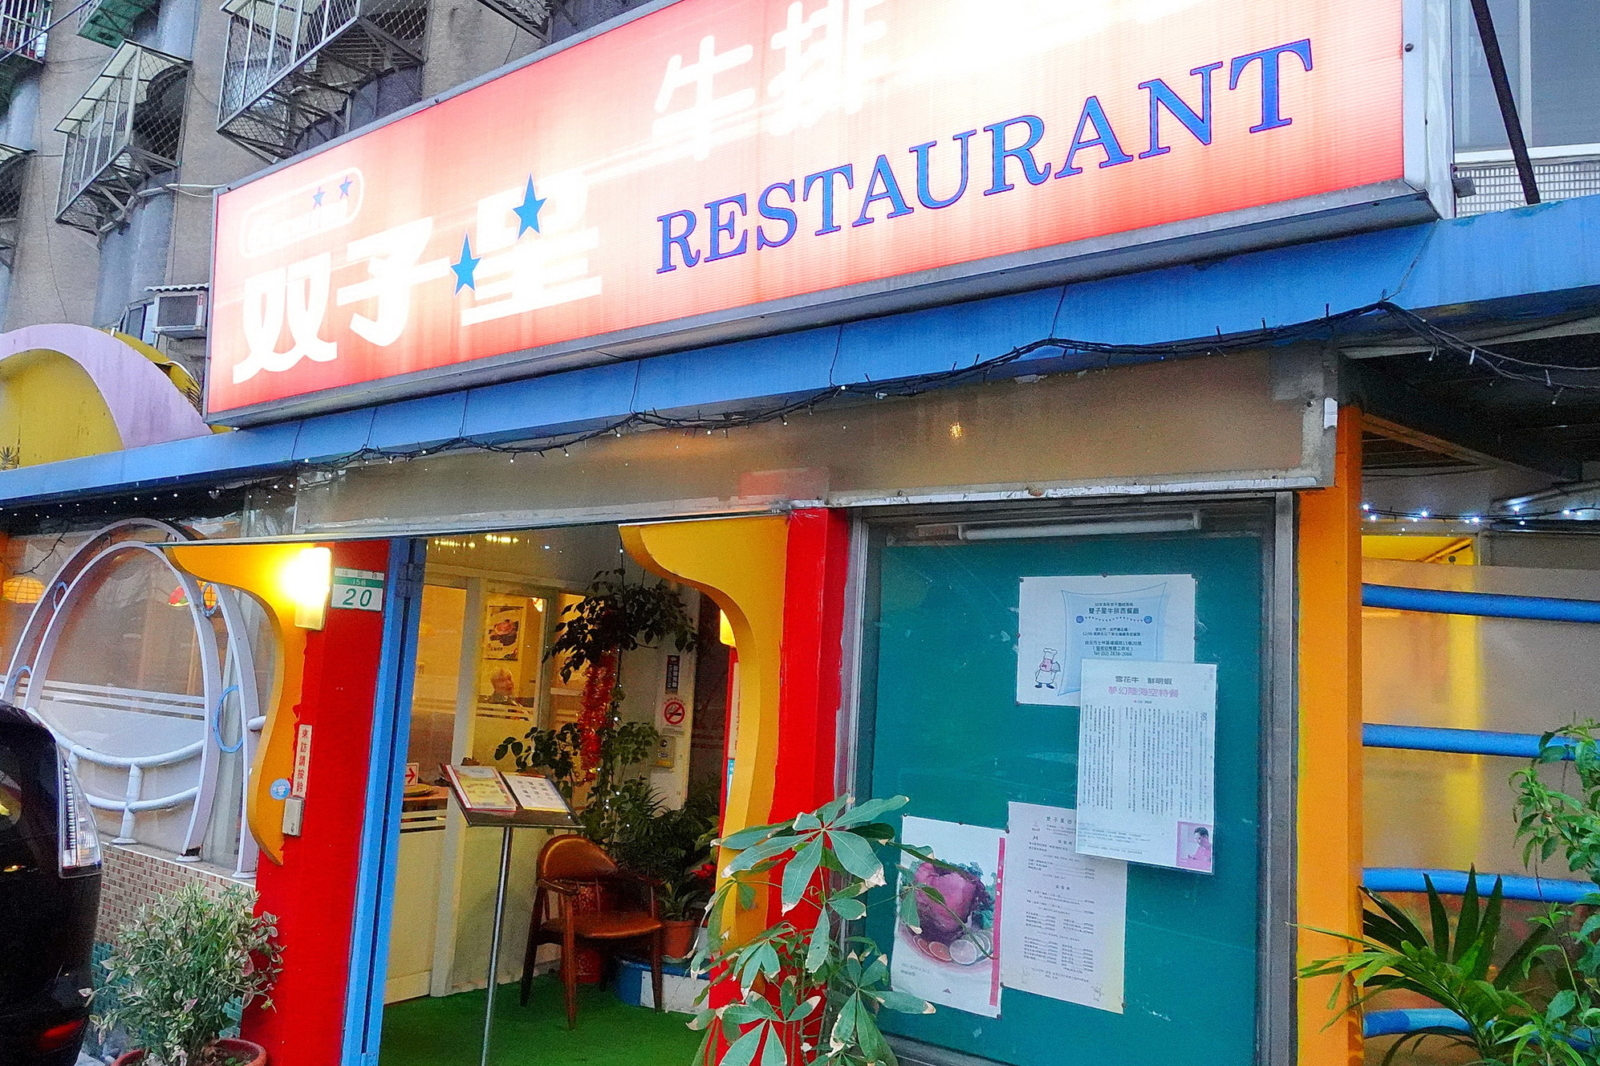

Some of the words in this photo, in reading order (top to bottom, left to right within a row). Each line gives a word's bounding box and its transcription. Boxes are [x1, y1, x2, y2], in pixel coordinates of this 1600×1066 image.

[657, 38, 1313, 275] RESTAURANT
[231, 170, 603, 385] 双子星
[342, 588, 373, 607] 20
